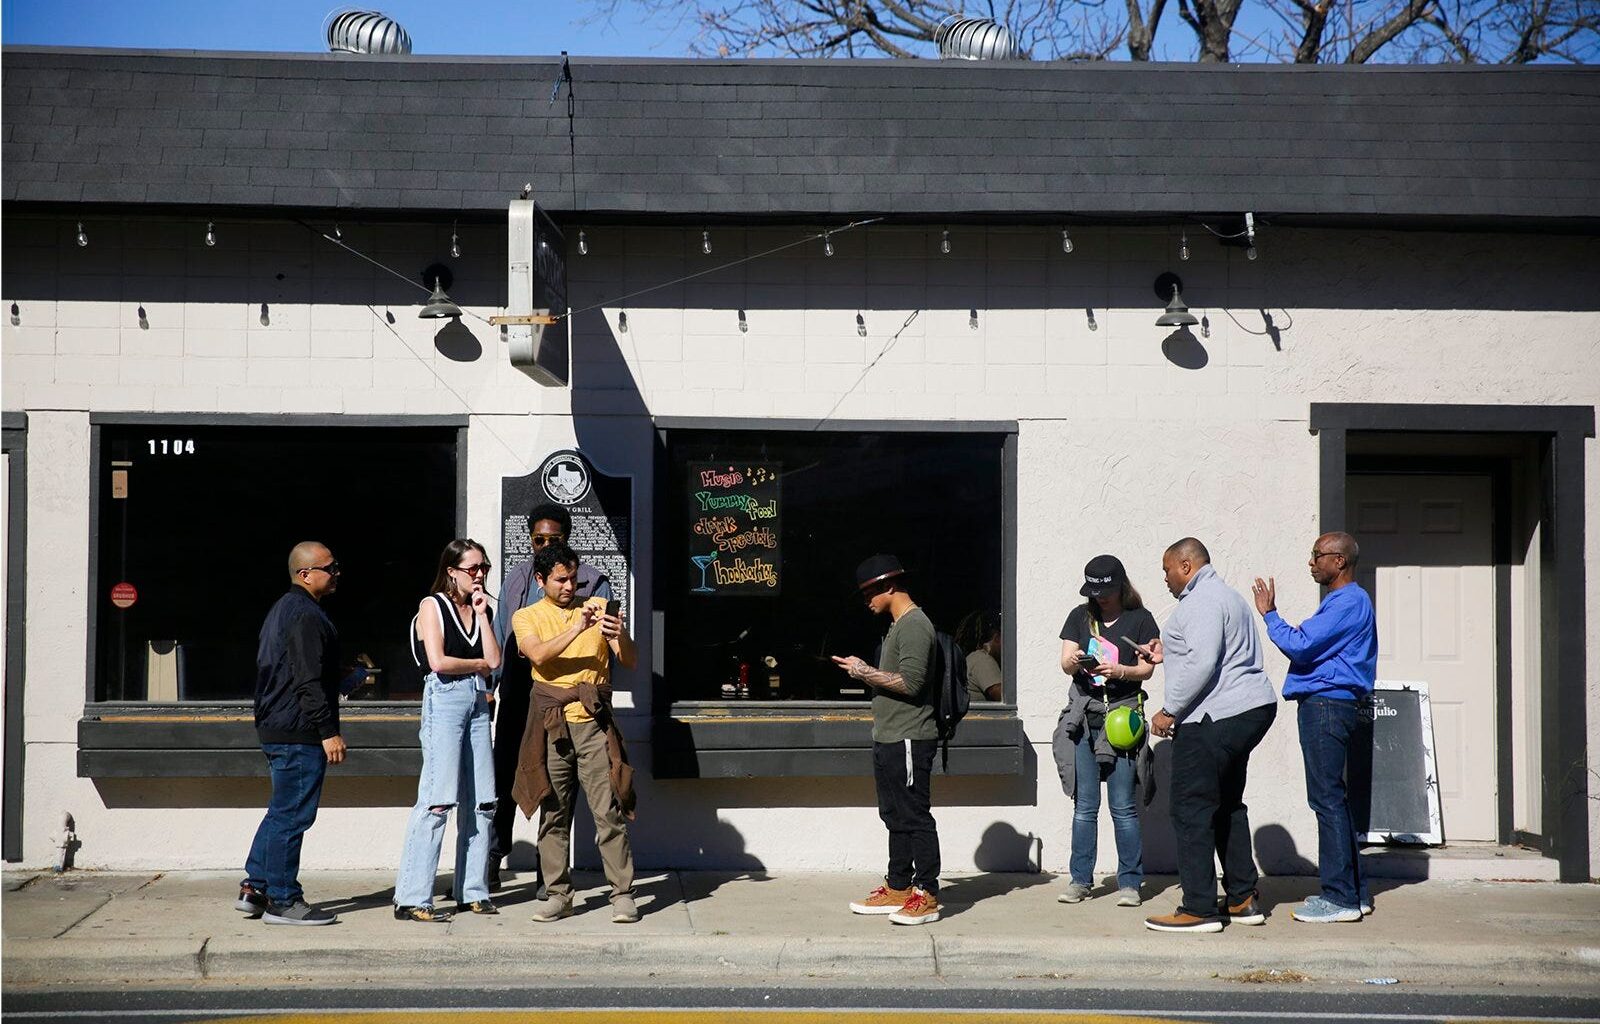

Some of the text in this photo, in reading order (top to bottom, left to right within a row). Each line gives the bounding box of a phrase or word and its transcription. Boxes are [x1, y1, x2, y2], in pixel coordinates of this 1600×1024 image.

[147, 439, 195, 455] 1104
[700, 466, 743, 488] Music
[695, 491, 777, 521] Yummy food
[693, 516, 737, 535] drink
[713, 526, 777, 553] Specials
[1371, 706, 1398, 721] Julio
